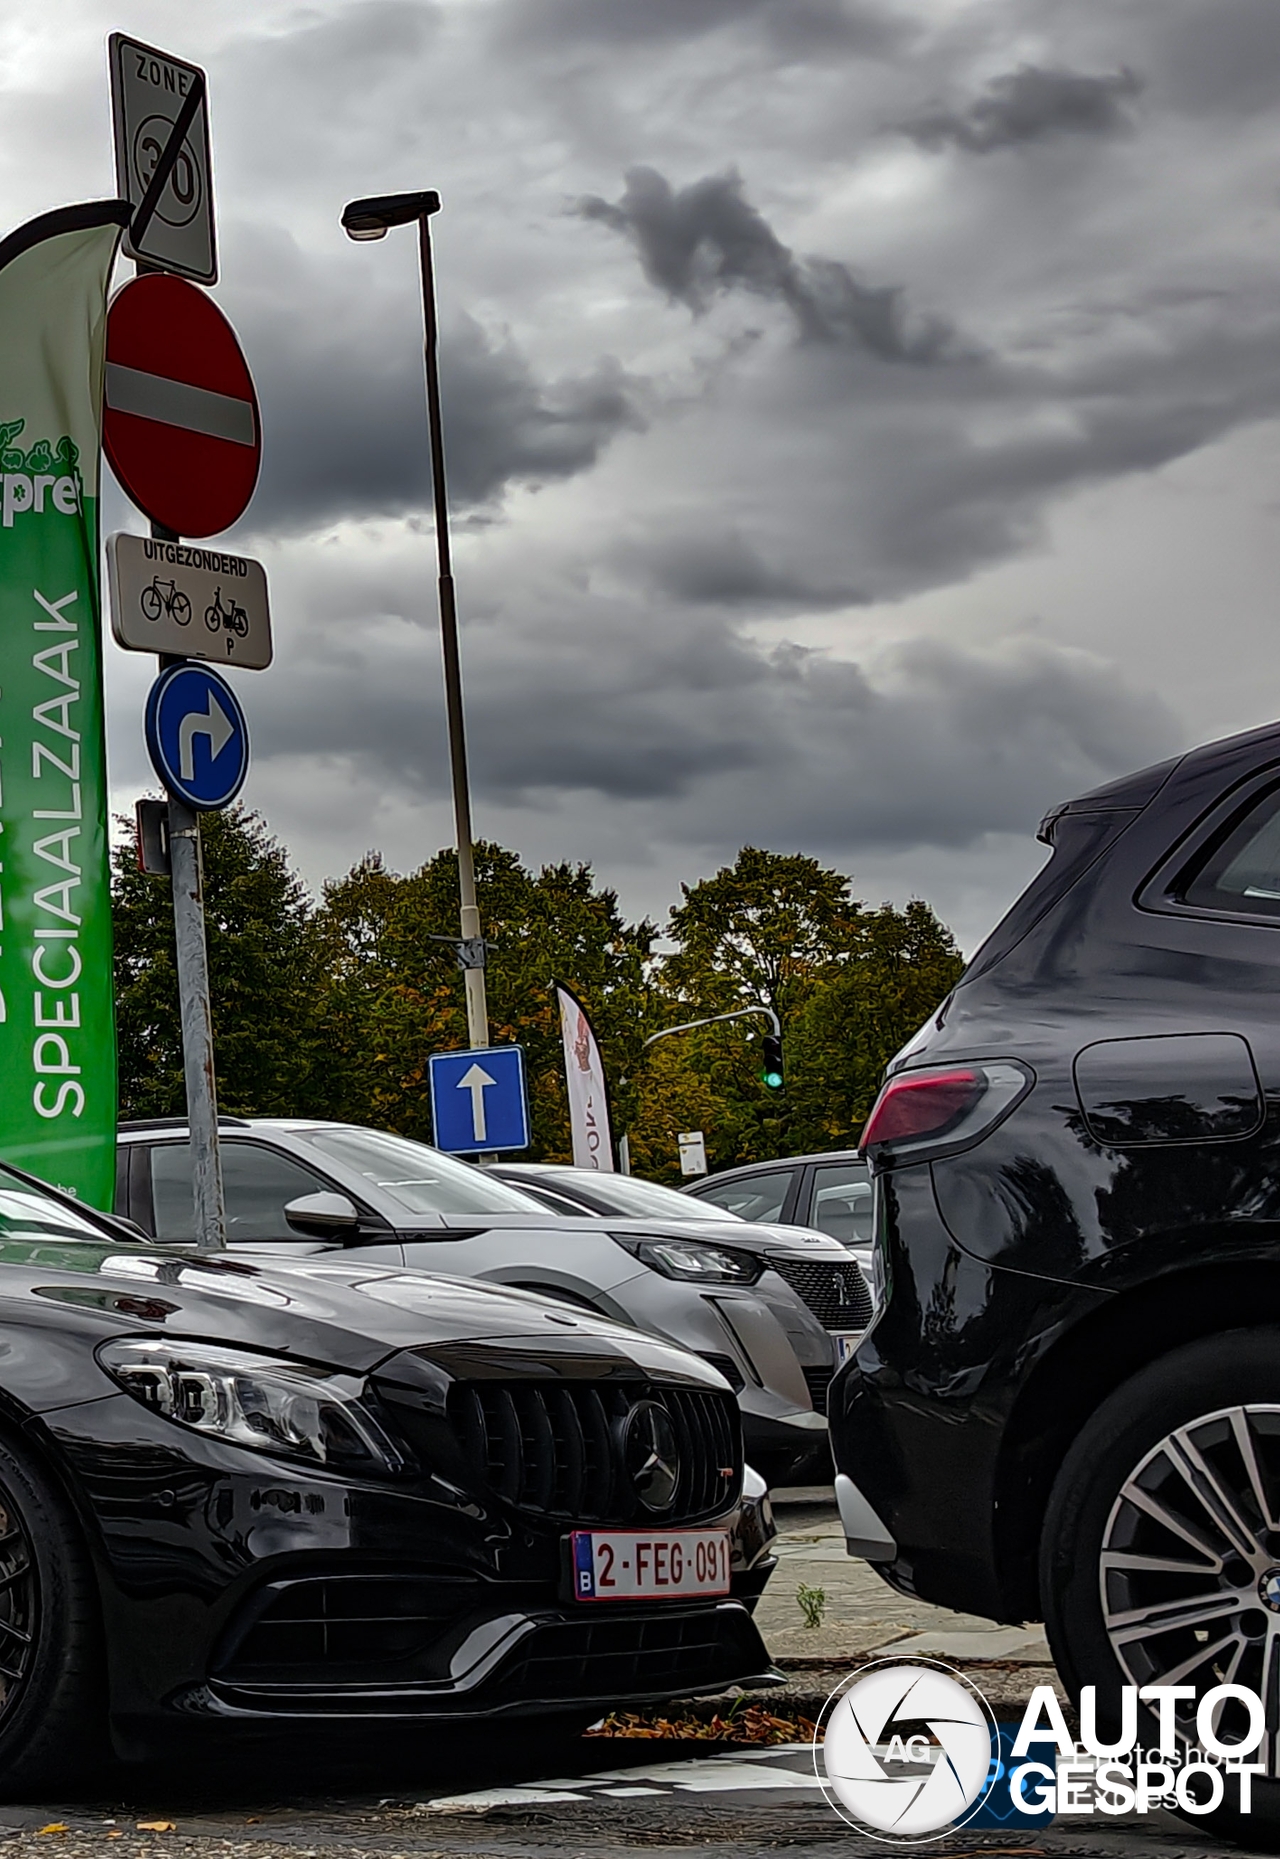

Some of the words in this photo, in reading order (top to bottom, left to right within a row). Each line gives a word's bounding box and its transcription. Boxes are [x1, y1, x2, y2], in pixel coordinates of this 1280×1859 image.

[135, 54, 189, 97] ZONE
[144, 539, 248, 578] UITGEZONDERD
[226, 637, 235, 656] P
[32, 588, 85, 1118] SPECIAALZAAK
[580, 1571, 592, 1592] B
